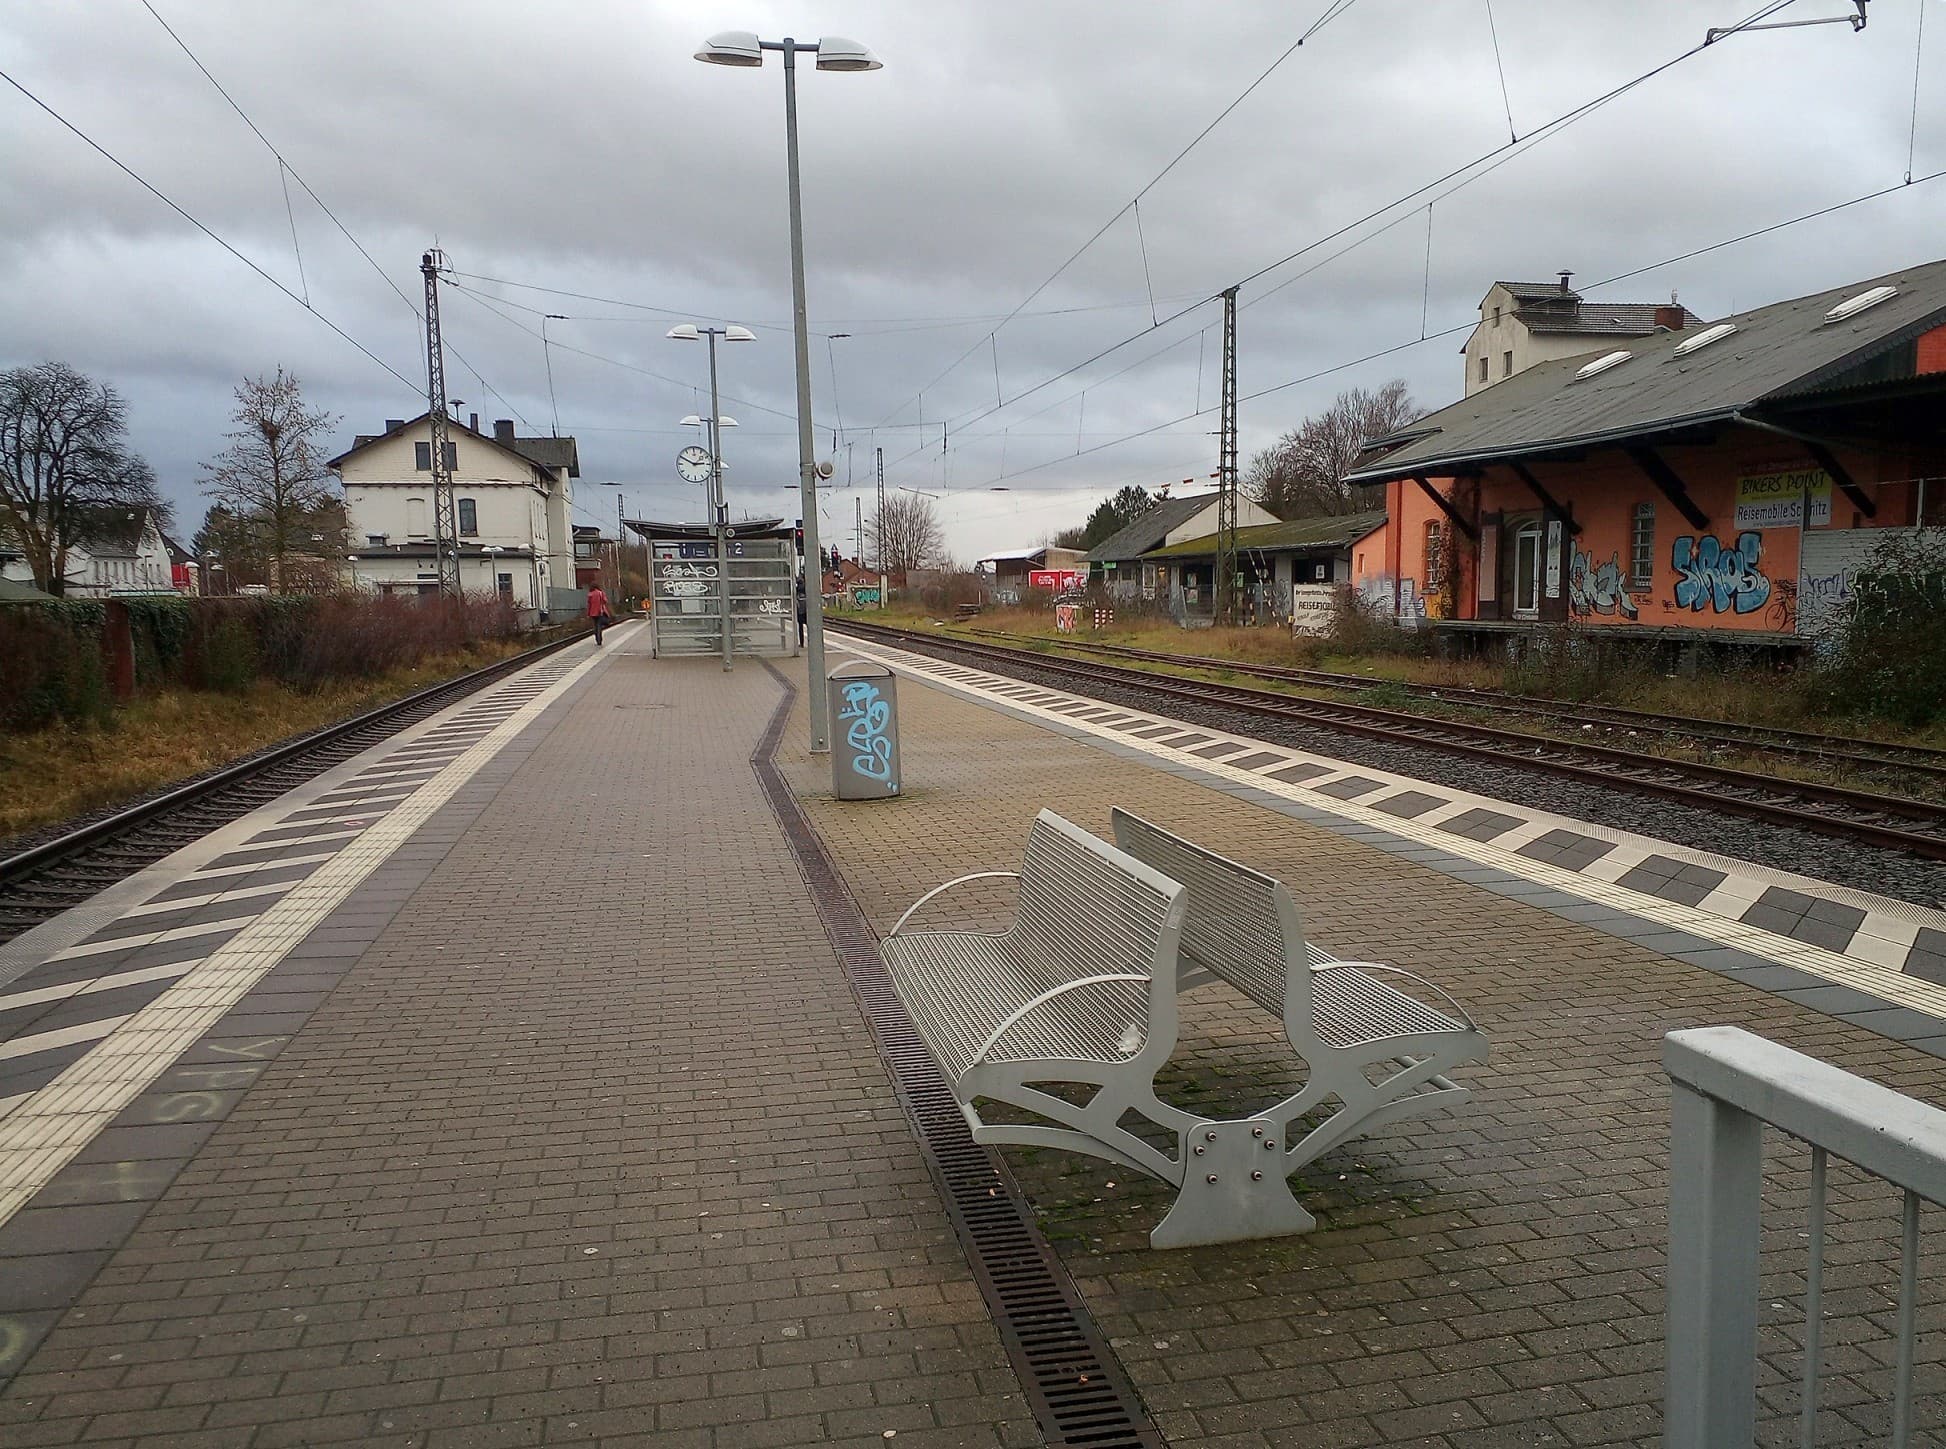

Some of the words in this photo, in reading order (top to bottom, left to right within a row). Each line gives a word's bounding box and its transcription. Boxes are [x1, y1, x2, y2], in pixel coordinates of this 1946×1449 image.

[1742, 475, 1782, 495] BIKERS
[1738, 503, 1788, 520] Reisemobile
[735, 542, 743, 554] 2
